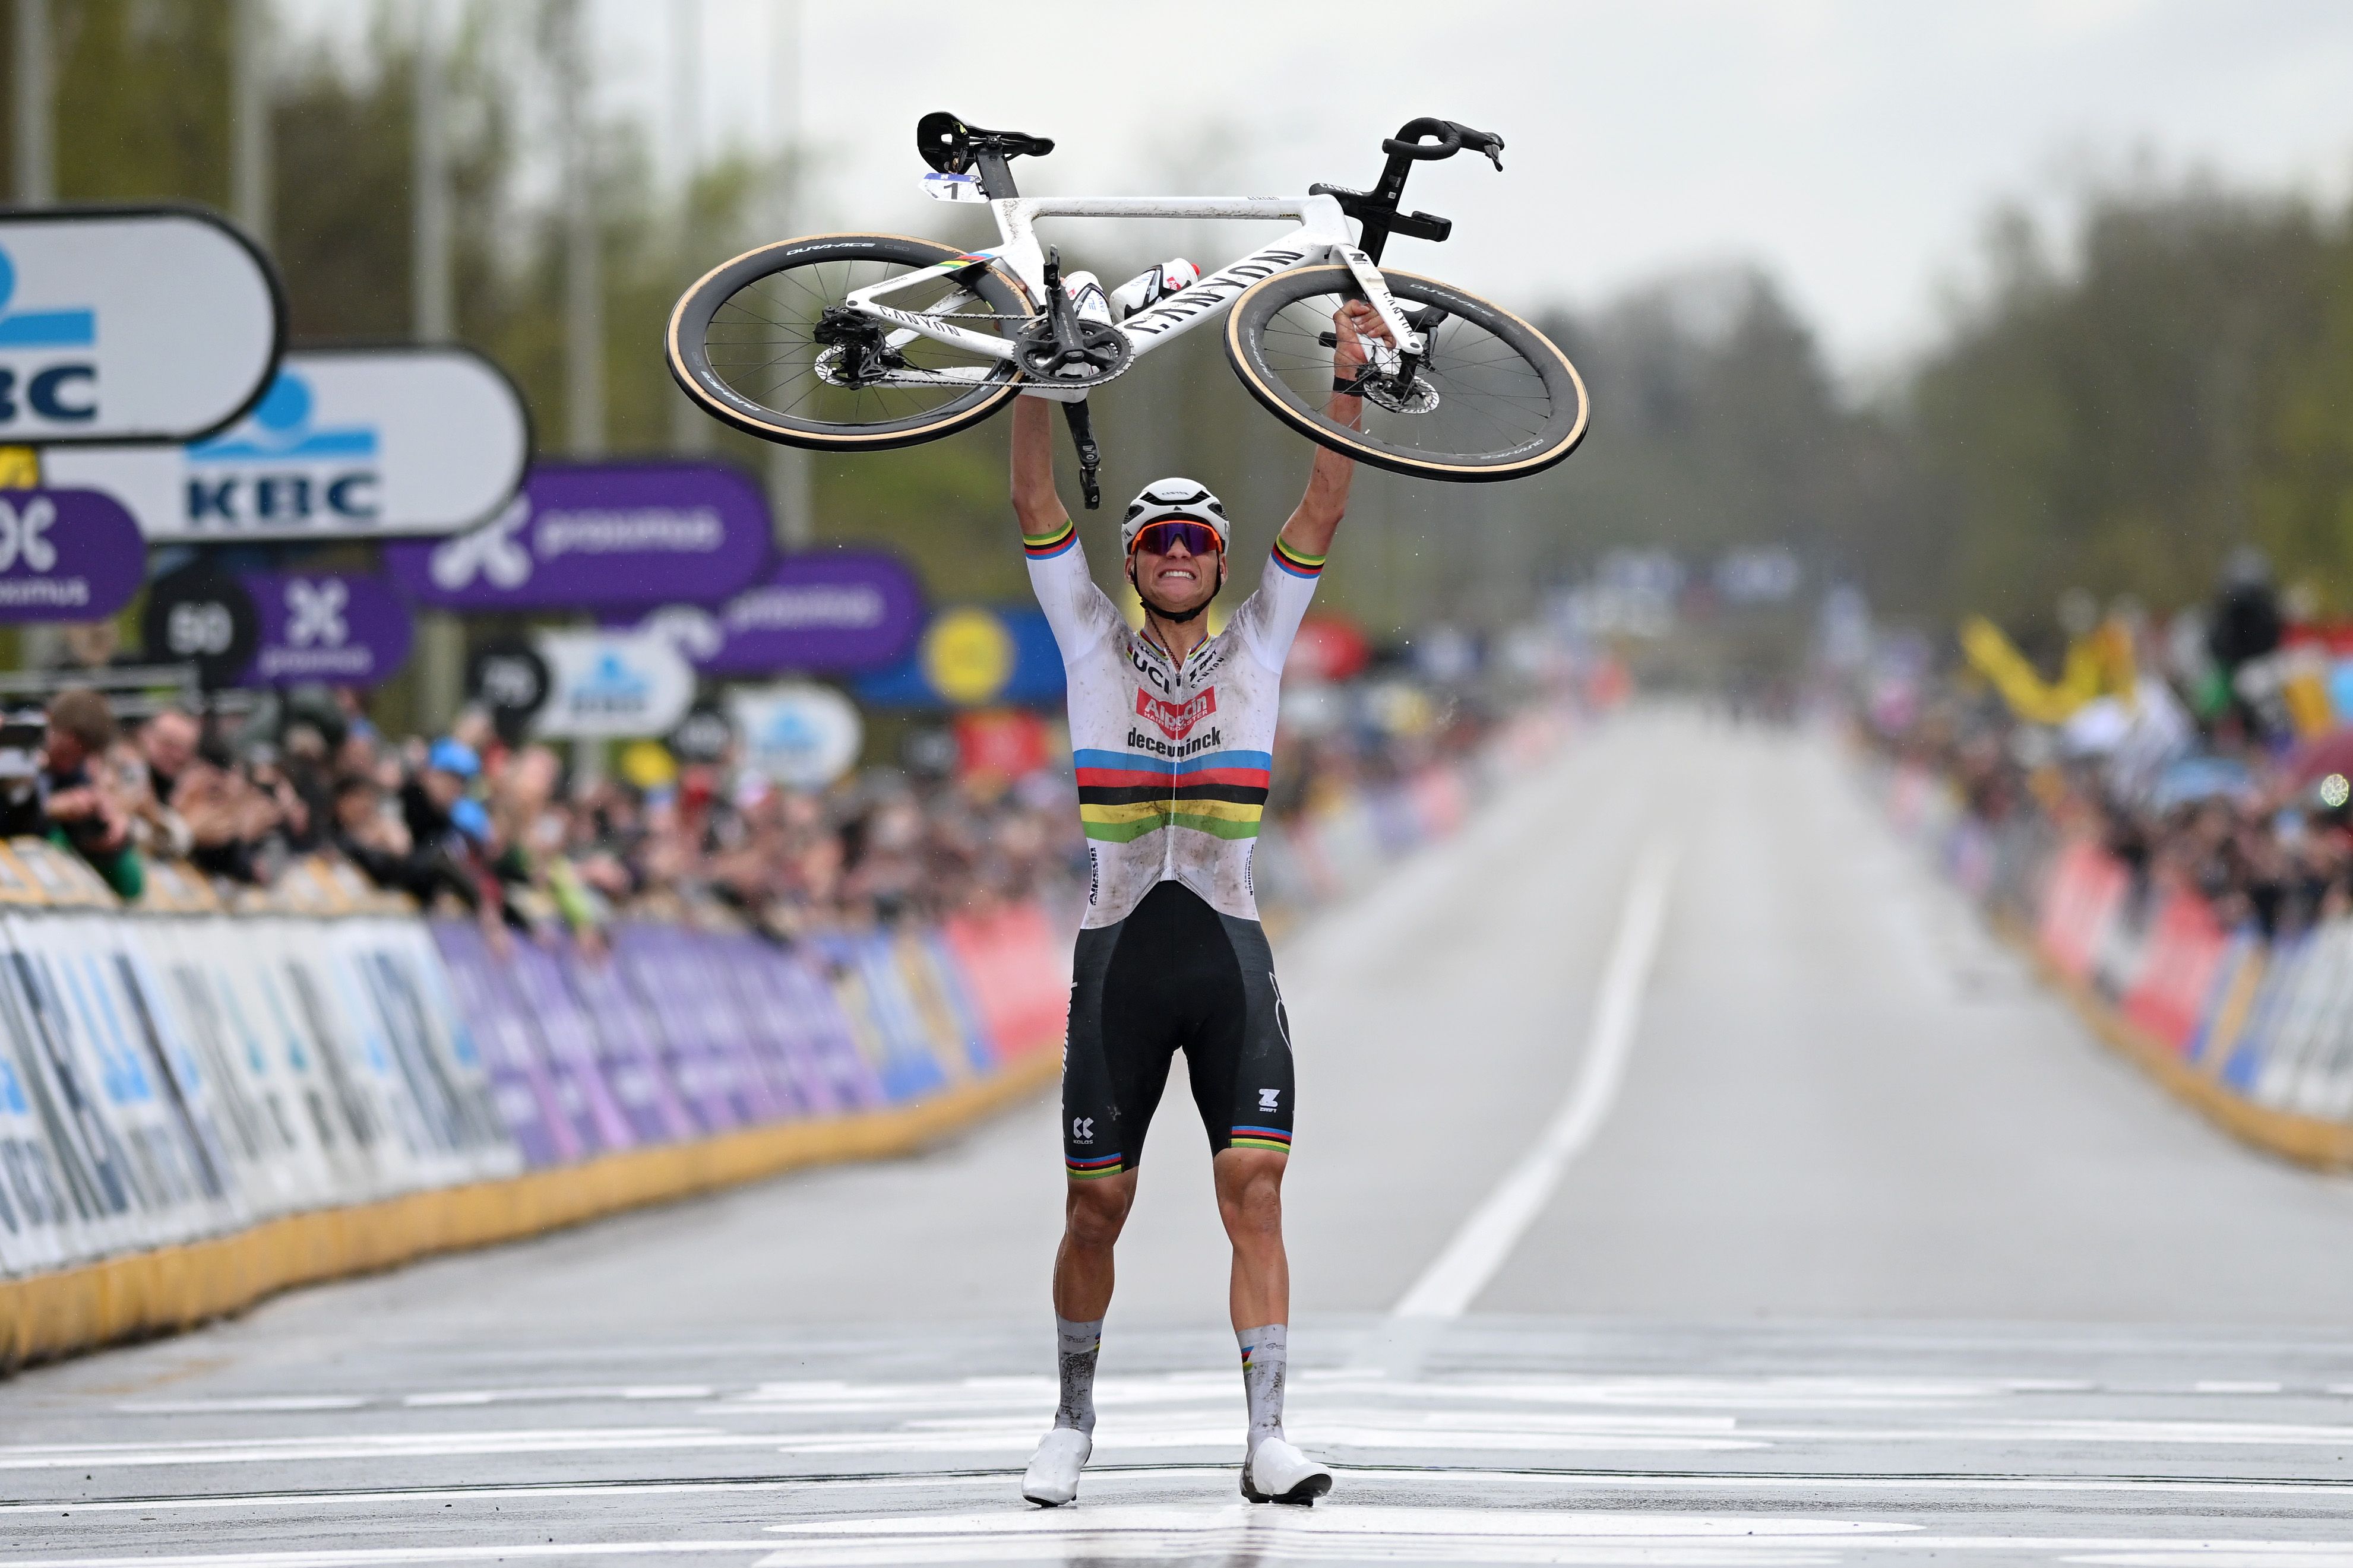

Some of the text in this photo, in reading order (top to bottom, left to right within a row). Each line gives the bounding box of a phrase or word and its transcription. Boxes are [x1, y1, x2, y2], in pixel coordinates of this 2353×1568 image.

[943, 182, 959, 200] 1
[1319, 182, 1363, 196] CANYON
[786, 242, 876, 256] DURA-ACE
[1124, 250, 1306, 335] CANYON
[1409, 283, 1495, 317] DURA-ACE
[878, 305, 961, 337] CANYON
[1383, 291, 1415, 337] CANYON
[700, 370, 761, 411] DURA-ACE
[185, 473, 381, 520] KBC
[1133, 650, 1170, 695] UCI
[1191, 657, 1225, 689] CANYON
[1144, 695, 1207, 728] Alpecin
[1128, 726, 1221, 758] deceuninck
[1089, 847, 1099, 906] Alpecin
